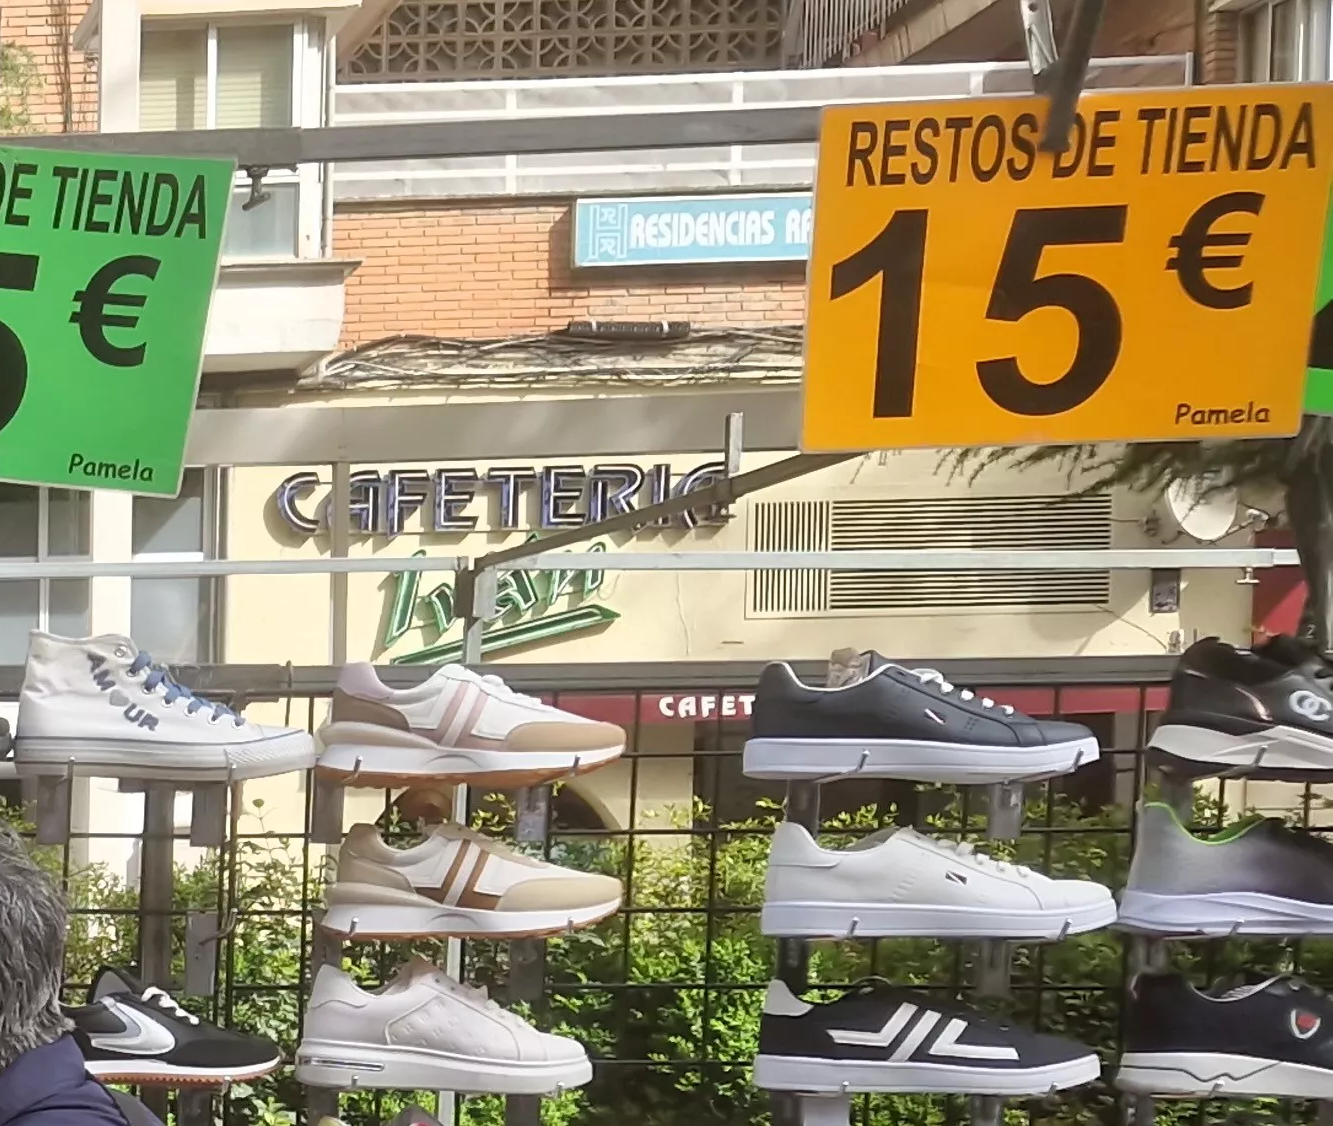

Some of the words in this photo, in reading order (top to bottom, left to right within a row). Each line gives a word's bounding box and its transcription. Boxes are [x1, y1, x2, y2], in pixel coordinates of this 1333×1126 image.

[846, 112, 1039, 188] RESTOS
[1052, 109, 1121, 179] DE
[1138, 101, 1317, 175] TIENDA
[51, 165, 208, 240] TIENDA
[630, 211, 776, 249] RESIDENCIAS
[68, 254, 162, 367] €
[830, 203, 1129, 419] 15
[1165, 191, 1266, 310] €
[1175, 401, 1271, 426] Pamela
[68, 453, 154, 482] Pamela
